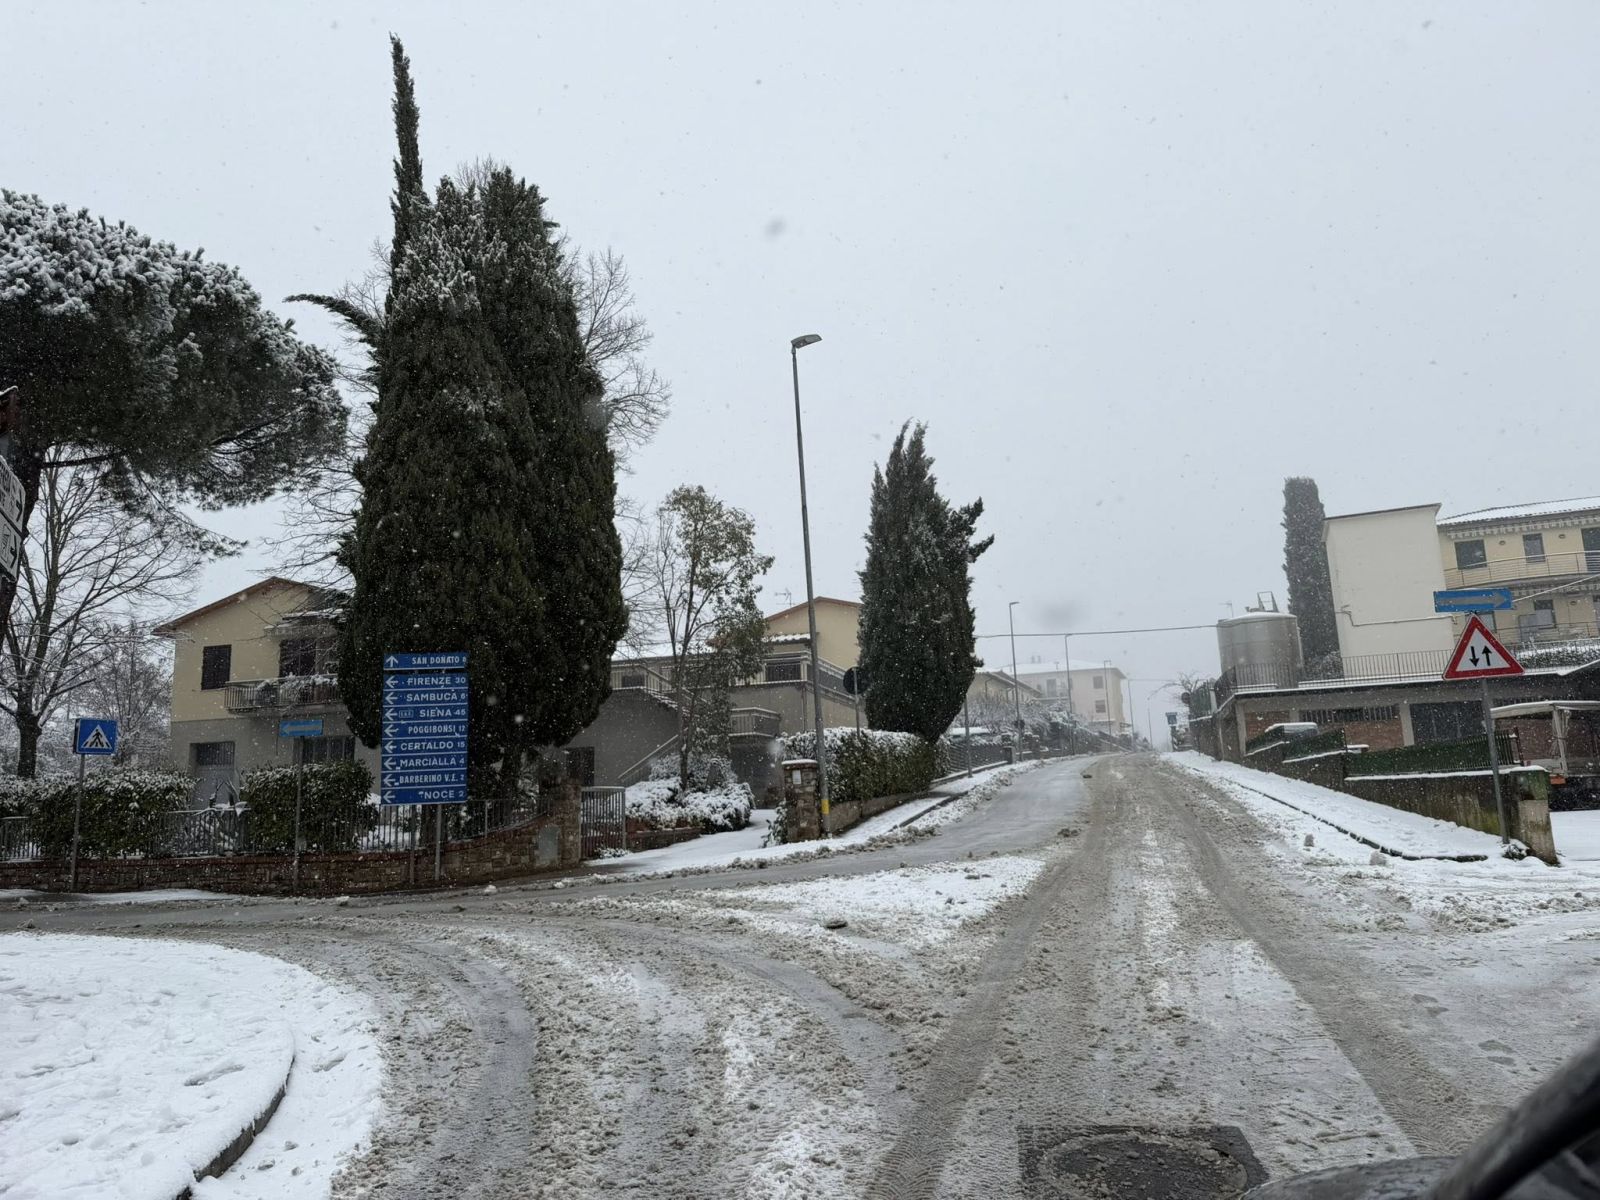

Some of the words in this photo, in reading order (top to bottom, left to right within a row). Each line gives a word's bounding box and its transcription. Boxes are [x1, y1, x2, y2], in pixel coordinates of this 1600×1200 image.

[411, 656, 427, 665] SAN
[430, 655, 460, 664] DONATO
[407, 676, 451, 685] FIRENZE
[406, 692, 457, 702] SAMBUCA
[419, 709, 452, 718] SIENA
[408, 725, 456, 734] POGGIBONSI
[400, 741, 454, 751] CERTALDO
[400, 757, 456, 767] MARCIALLA
[399, 774, 442, 784] BARBERINO
[424, 790, 455, 799] NOCE
